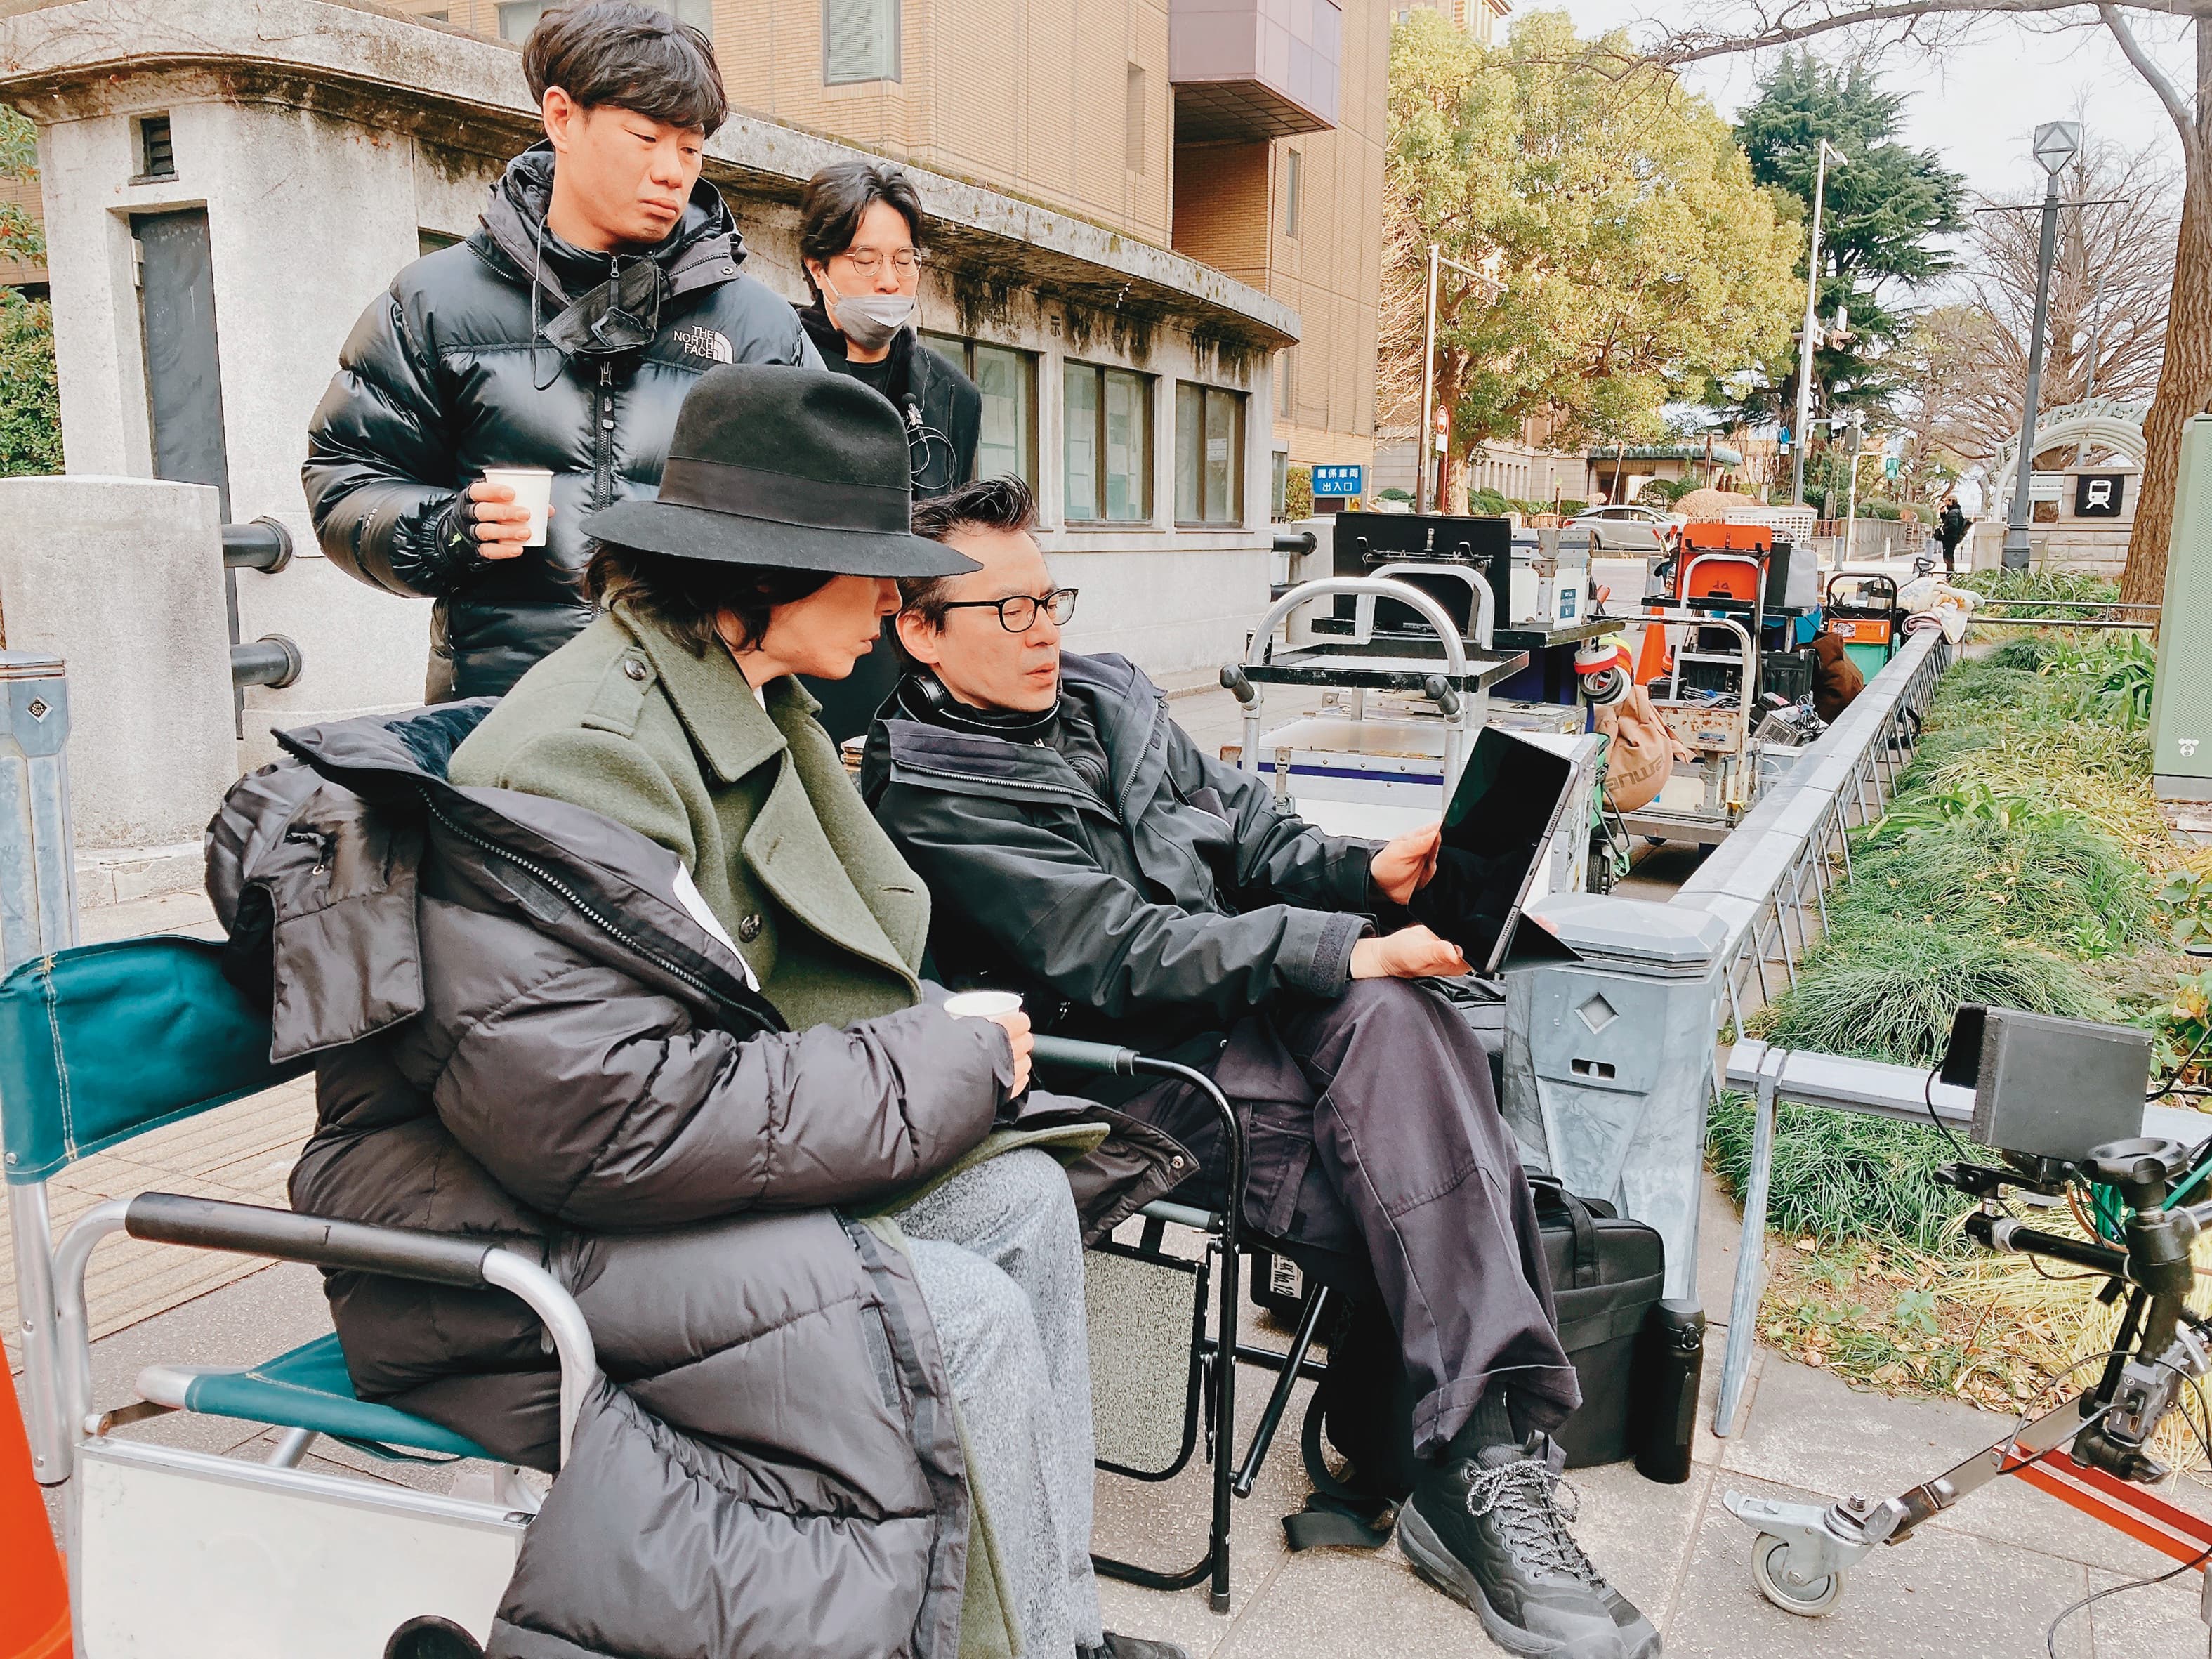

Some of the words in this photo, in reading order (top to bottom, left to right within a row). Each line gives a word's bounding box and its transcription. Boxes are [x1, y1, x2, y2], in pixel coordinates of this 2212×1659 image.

[692, 325, 714, 339] THE
[673, 331, 714, 349] NORTH
[684, 343, 713, 359] FACE
[1317, 468, 1359, 479] 関係車両
[1322, 482, 1352, 492] 出入口
